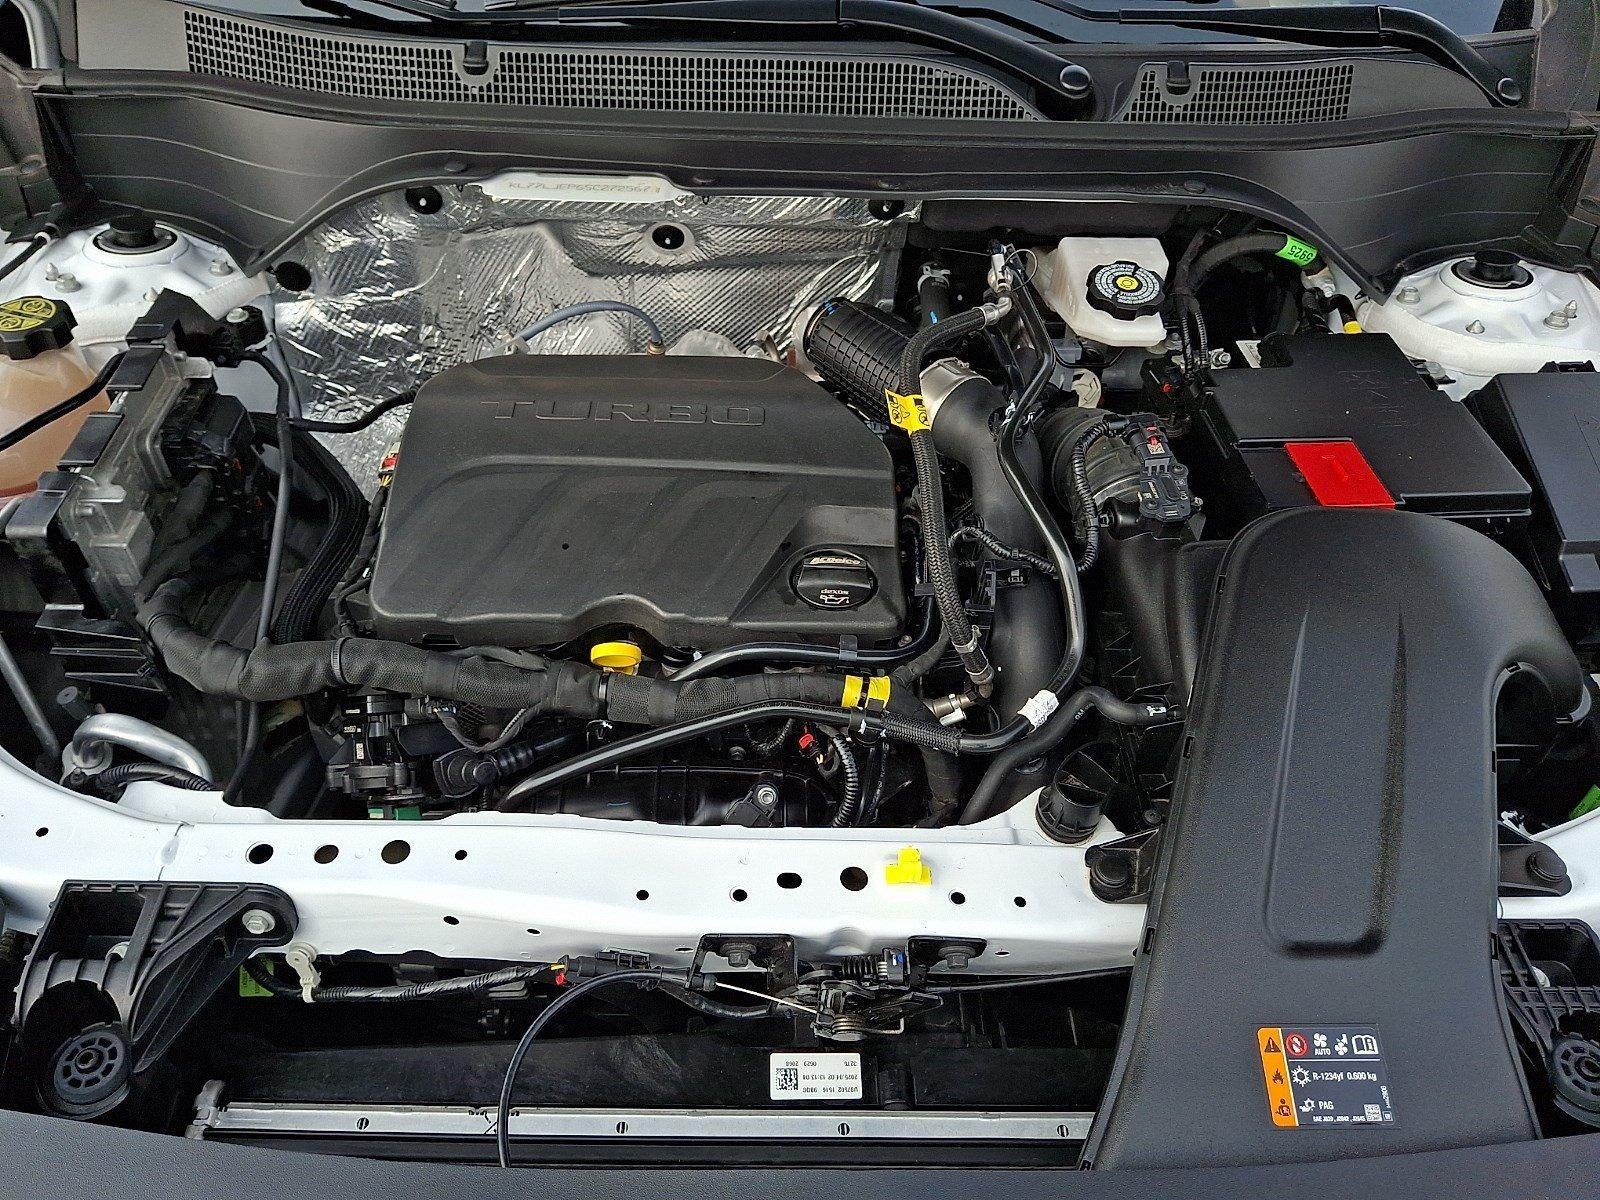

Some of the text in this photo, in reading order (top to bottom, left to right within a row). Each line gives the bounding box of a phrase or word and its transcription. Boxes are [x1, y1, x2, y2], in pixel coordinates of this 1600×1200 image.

[1288, 245, 1314, 262] 5925
[481, 400, 766, 426] TURBO
[1314, 1048, 1332, 1056] AUTO
[1346, 1072, 1367, 1080] 0.600
[1367, 1072, 1378, 1082] kg
[1318, 1101, 1334, 1110] PAG
